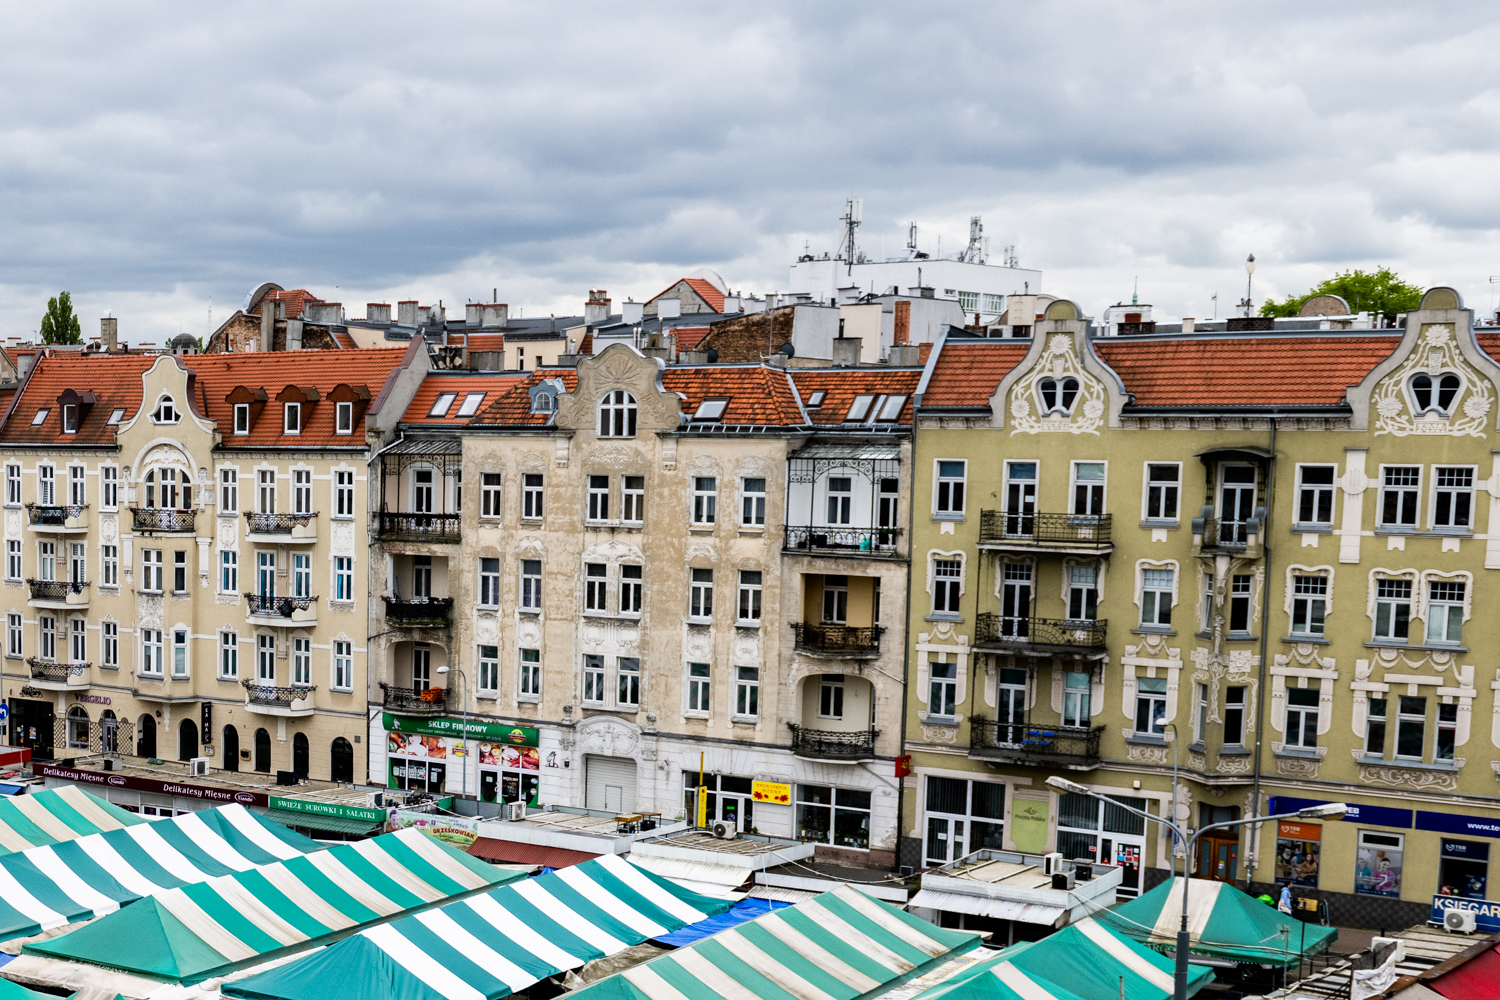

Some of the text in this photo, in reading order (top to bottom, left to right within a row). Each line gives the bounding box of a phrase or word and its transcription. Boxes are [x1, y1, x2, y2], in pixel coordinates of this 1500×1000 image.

[74, 693, 112, 705] VERGELIO
[428, 720, 488, 734] SKLEP FIRMOWY
[43, 767, 79, 781] Delikatesy
[80, 771, 105, 783] Mięsne
[163, 783, 202, 797] Delikatesy
[204, 788, 231, 800] Mięsne
[305, 802, 337, 814] SURÓWKI
[339, 807, 343, 815] I
[432, 826, 475, 839] GRZEŚKOWIAK
